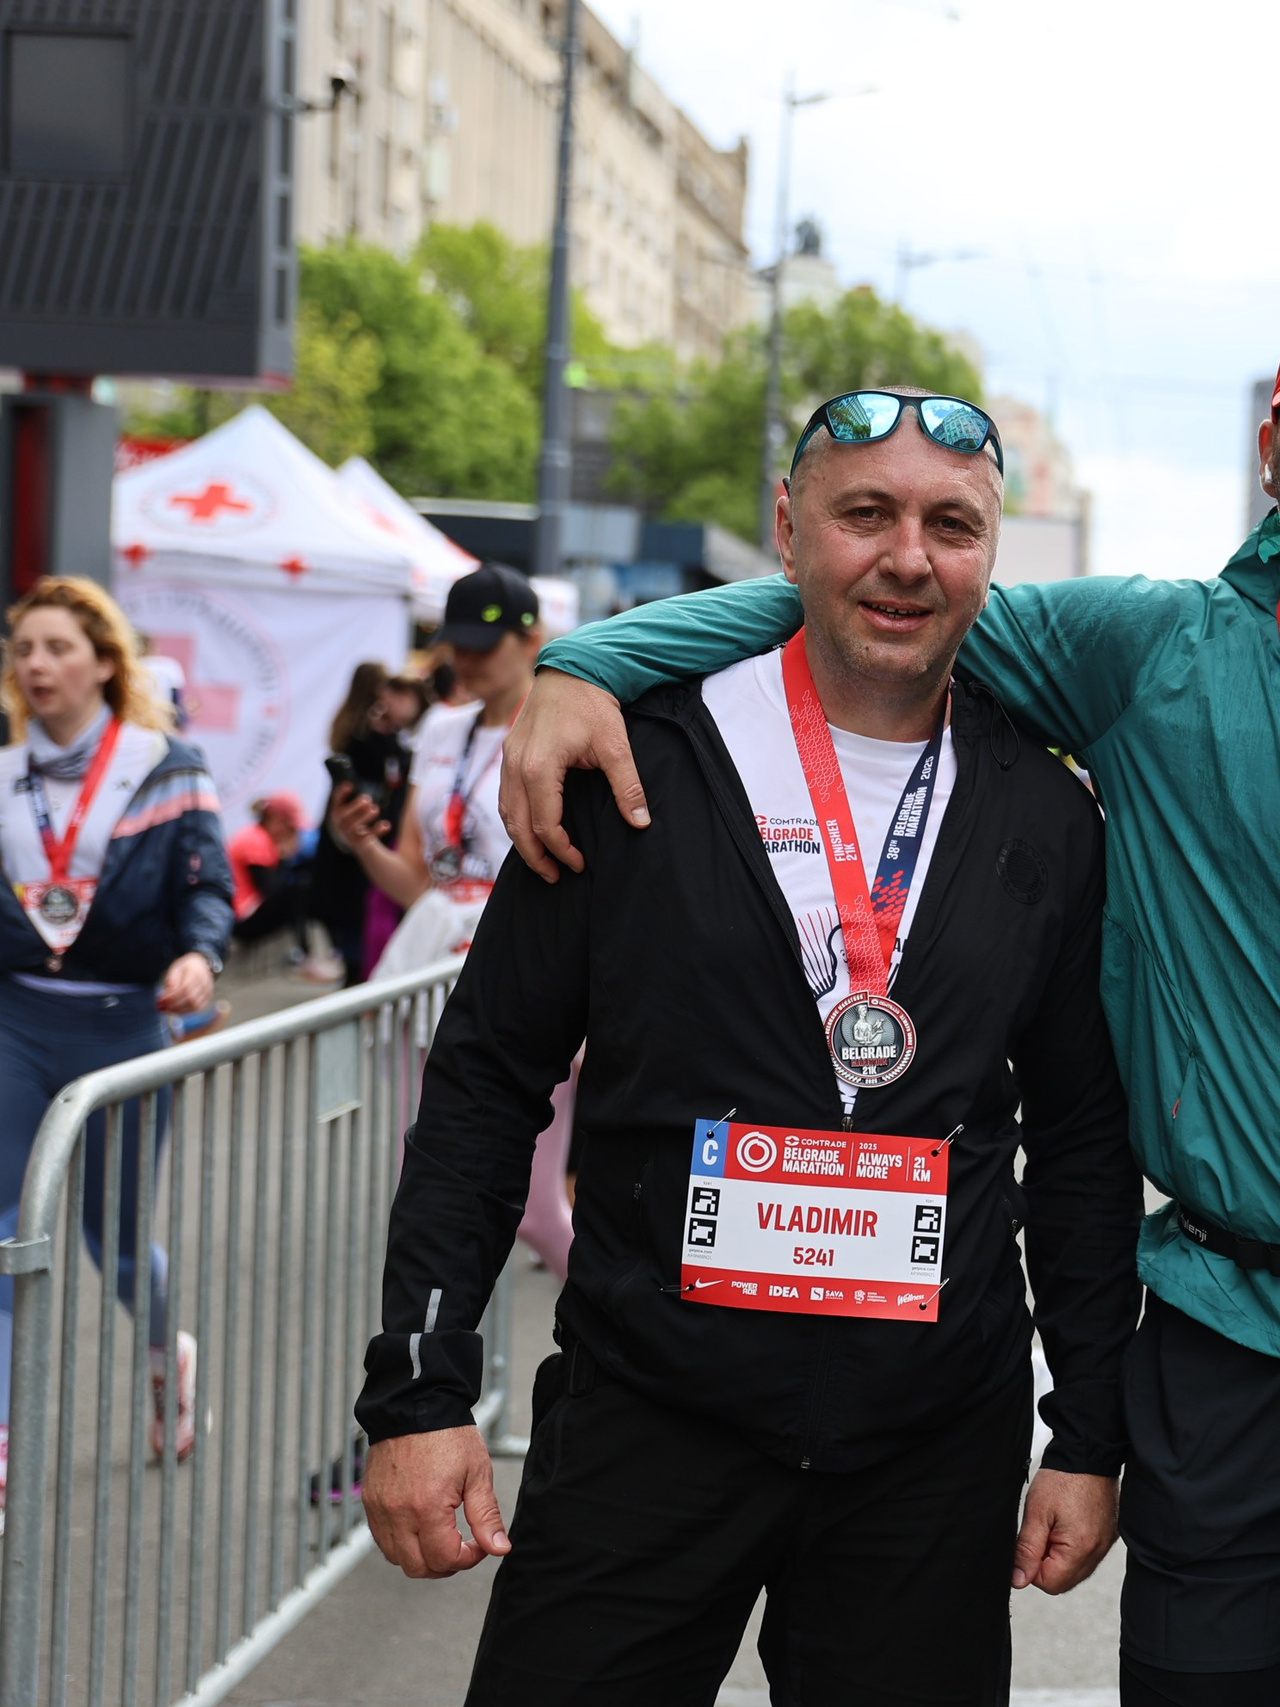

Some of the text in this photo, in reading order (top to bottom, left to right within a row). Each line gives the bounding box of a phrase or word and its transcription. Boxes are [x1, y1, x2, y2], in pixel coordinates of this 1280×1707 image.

[920, 755, 935, 780] 2025
[904, 786, 928, 837] MARATHON
[886, 792, 916, 860] 38TH BELGRADE
[760, 827, 814, 840] ELGRADE
[826, 819, 846, 862] FINISHER
[764, 840, 820, 854] ARATHON
[843, 843, 858, 861] 21K
[841, 1045, 897, 1060] BELGRADE
[862, 1065, 877, 1075] 21K
[801, 1138, 847, 1148] COMTRADE
[859, 1142, 877, 1150] 2025
[702, 1139, 719, 1166] C
[783, 1147, 840, 1163] BELGRADE
[857, 1152, 903, 1168] ALWAYS
[914, 1156, 926, 1169] 21
[782, 1159, 844, 1177] MARATHON
[856, 1165, 889, 1179] MORE
[912, 1169, 931, 1182] KM
[757, 1202, 878, 1237] VLADIMIR
[793, 1246, 835, 1267] 5241
[731, 1280, 758, 1290] POWER
[768, 1285, 799, 1298] iDEA
[825, 1290, 844, 1298] SAVA
[897, 1293, 925, 1306] Wellness
